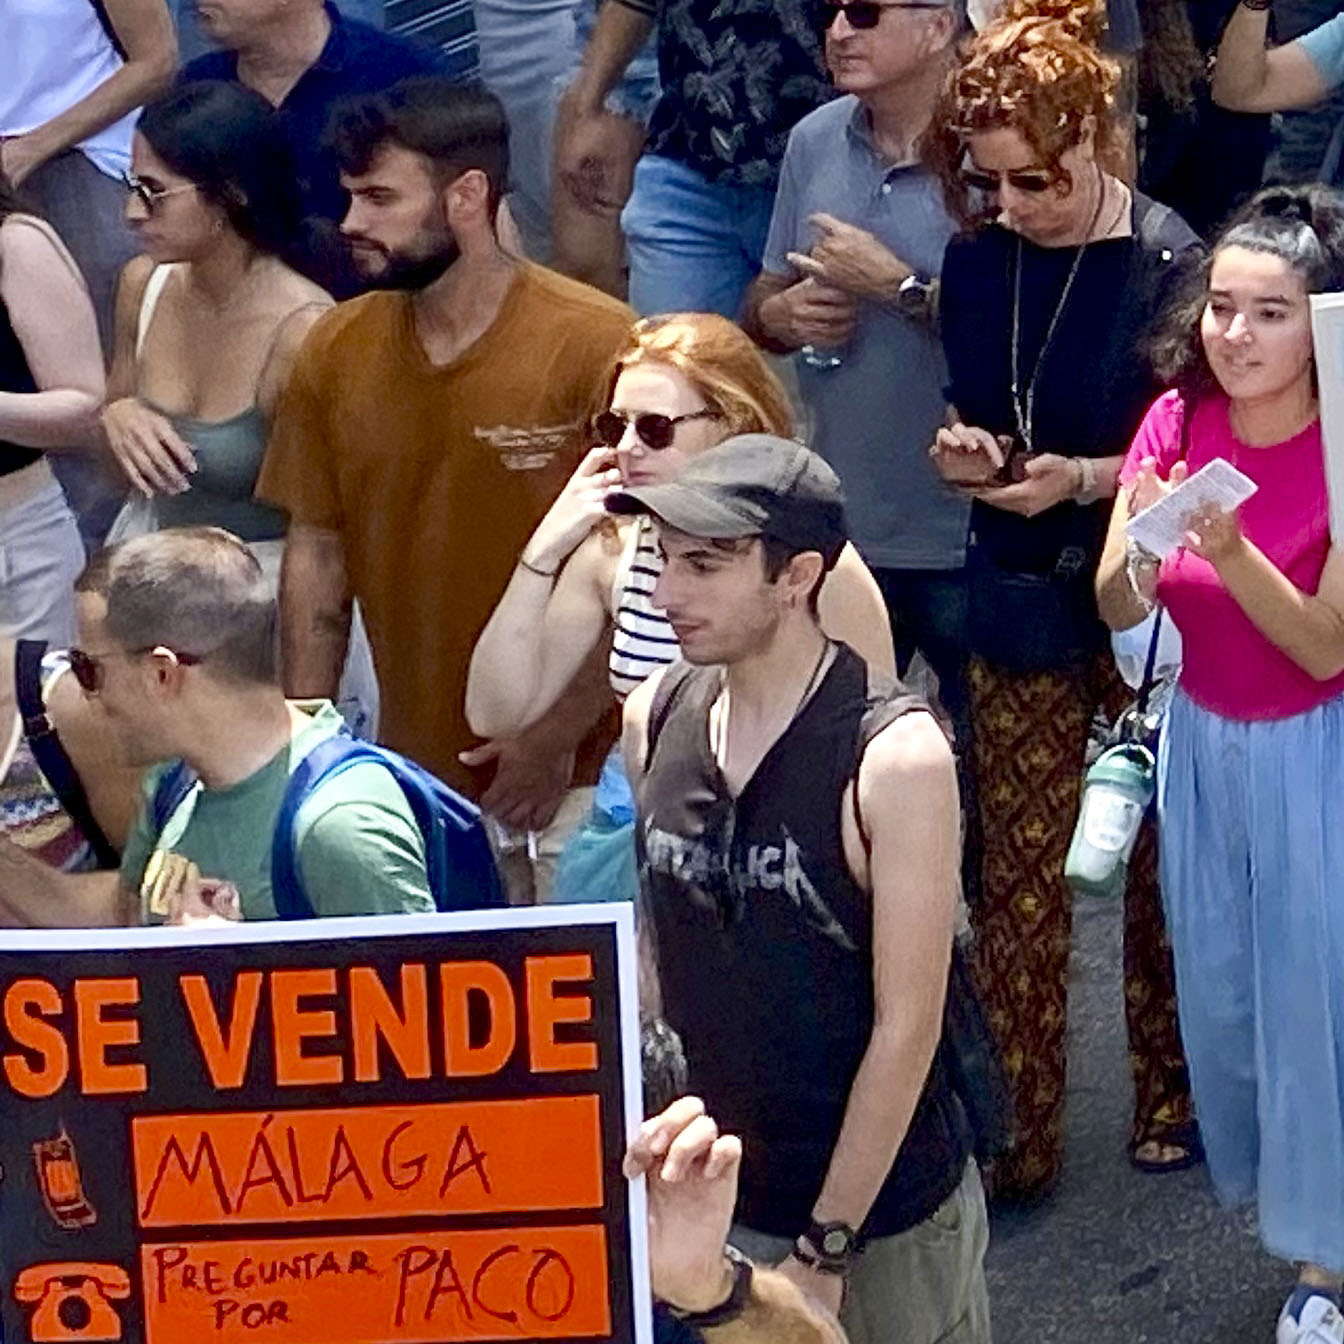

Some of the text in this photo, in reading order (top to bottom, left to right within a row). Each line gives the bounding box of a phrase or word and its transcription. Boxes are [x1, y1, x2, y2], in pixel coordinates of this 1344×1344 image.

[3, 953, 600, 1097] SE VENDE
[140, 1114, 492, 1221] MÁLAGA
[153, 1244, 576, 1328] PREGUNTAR PACO
[214, 1297, 292, 1330] POR
